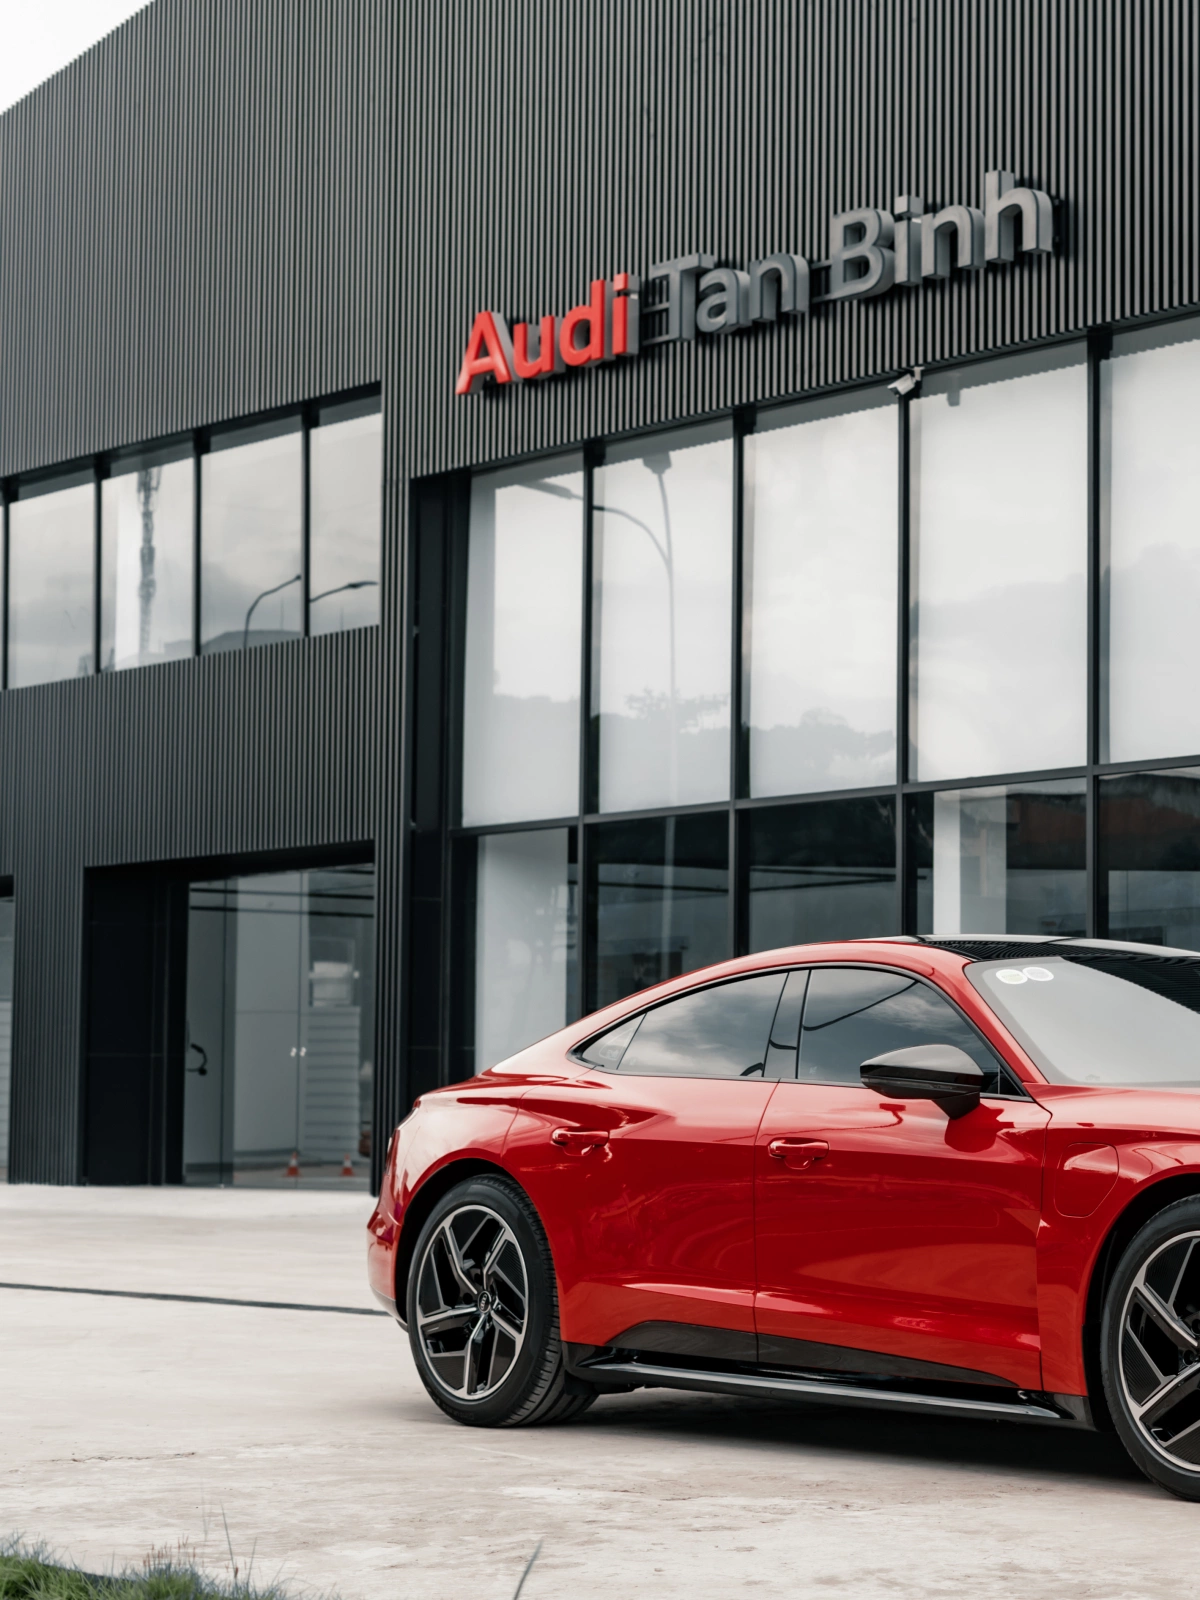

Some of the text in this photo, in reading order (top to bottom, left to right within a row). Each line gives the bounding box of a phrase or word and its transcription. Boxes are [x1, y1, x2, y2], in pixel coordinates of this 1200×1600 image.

[455, 169, 1053, 395] Audi Tan Binh
